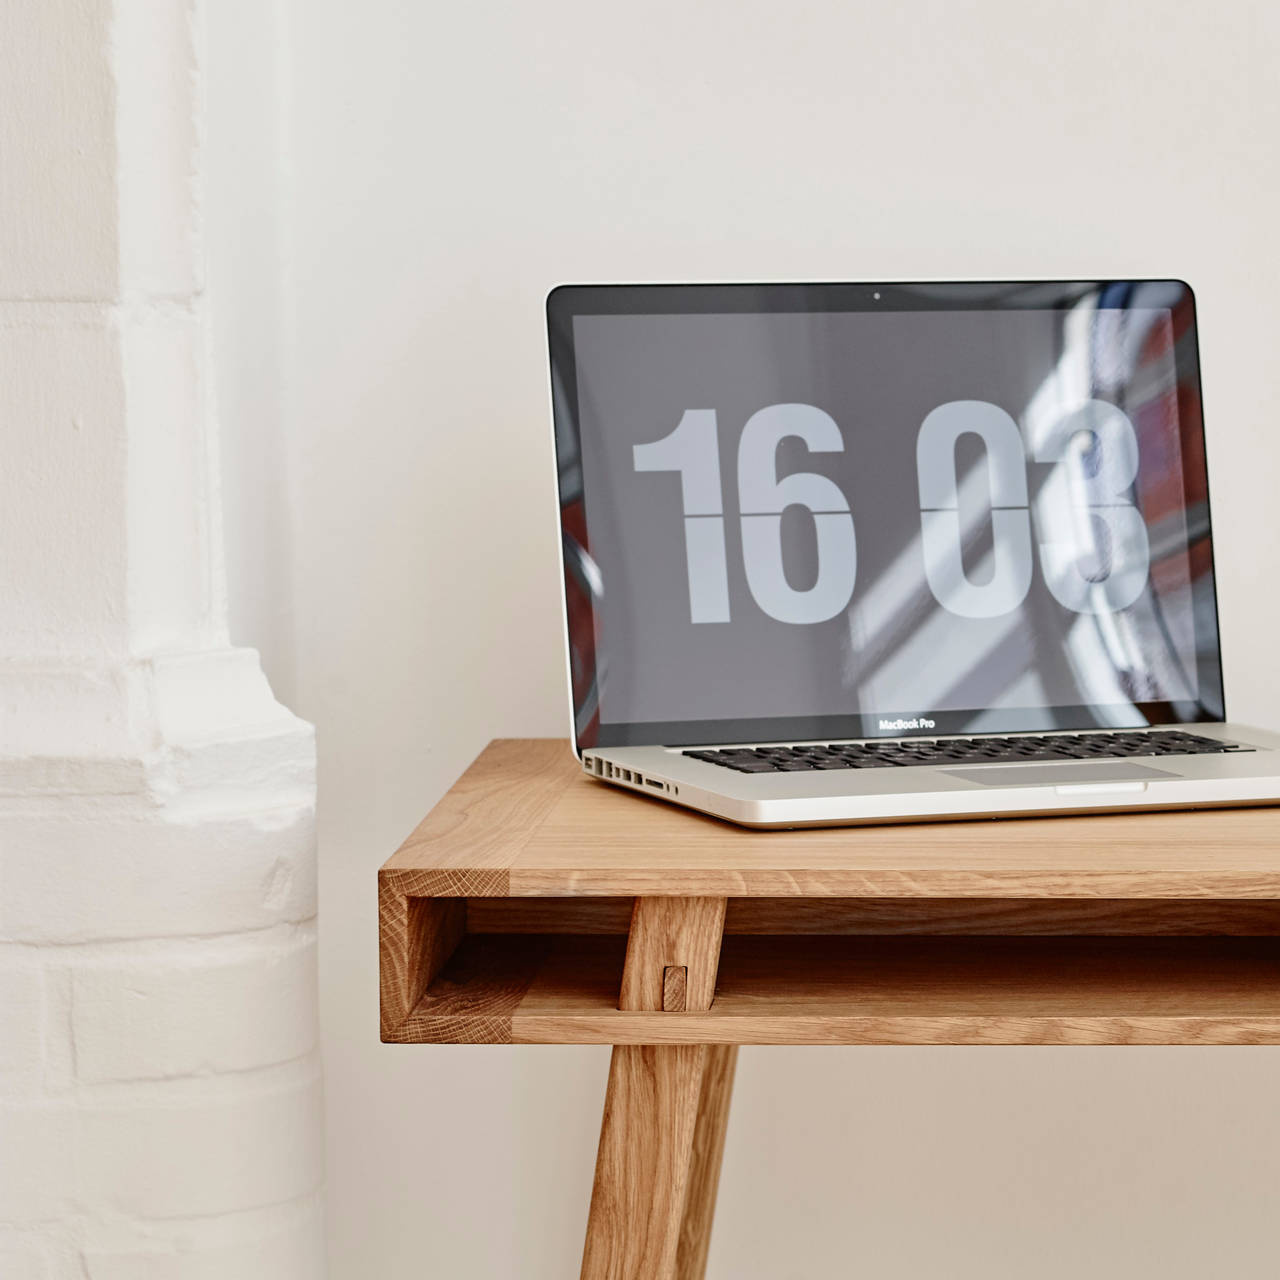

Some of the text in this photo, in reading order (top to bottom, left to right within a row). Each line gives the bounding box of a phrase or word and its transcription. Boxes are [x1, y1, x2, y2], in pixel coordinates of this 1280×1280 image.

[632, 403, 857, 624] 16
[879, 718, 936, 730] MacBook Pro
